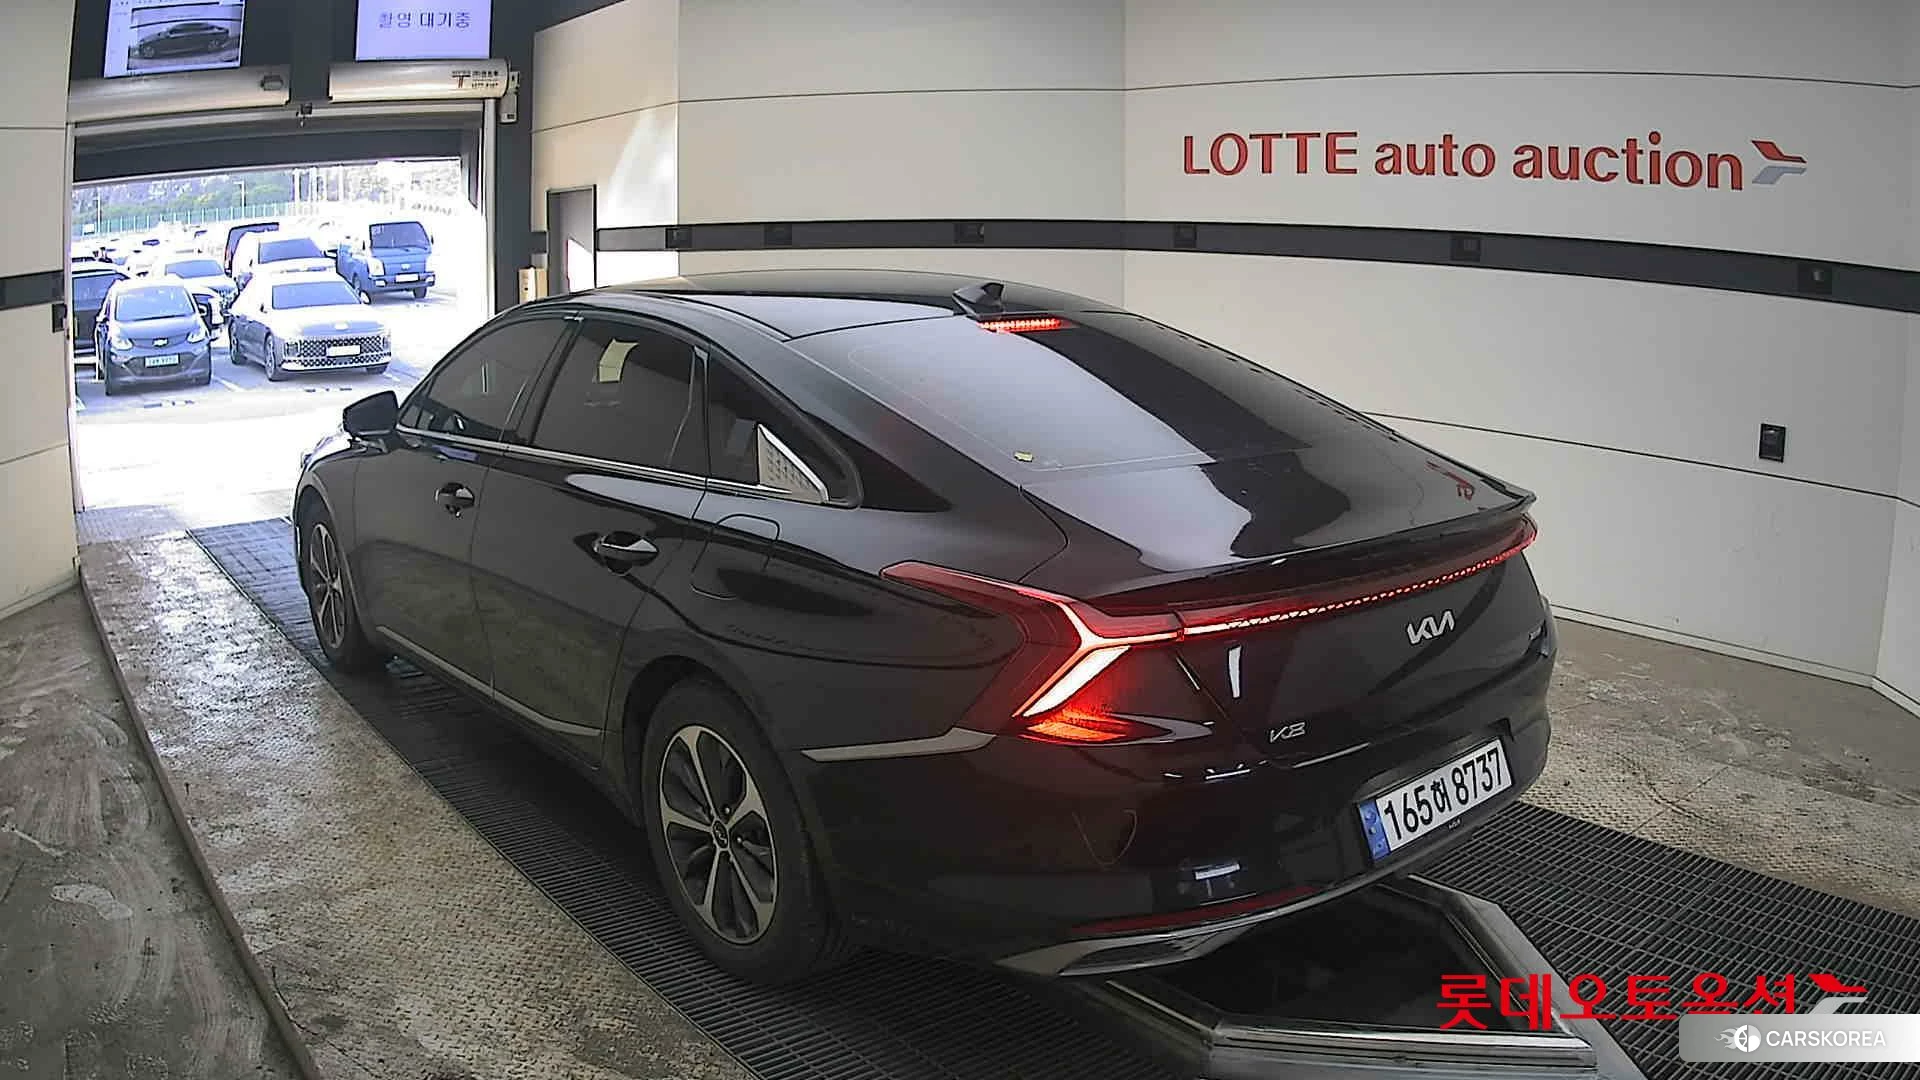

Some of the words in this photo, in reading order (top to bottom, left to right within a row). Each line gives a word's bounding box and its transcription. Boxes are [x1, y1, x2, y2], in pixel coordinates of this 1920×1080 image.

[420, 11, 472, 29] 대기중
[1184, 131, 1358, 176] LOTTE
[1375, 134, 1497, 177] auto
[1512, 131, 1744, 191] auction
[1269, 721, 1306, 743] K8
